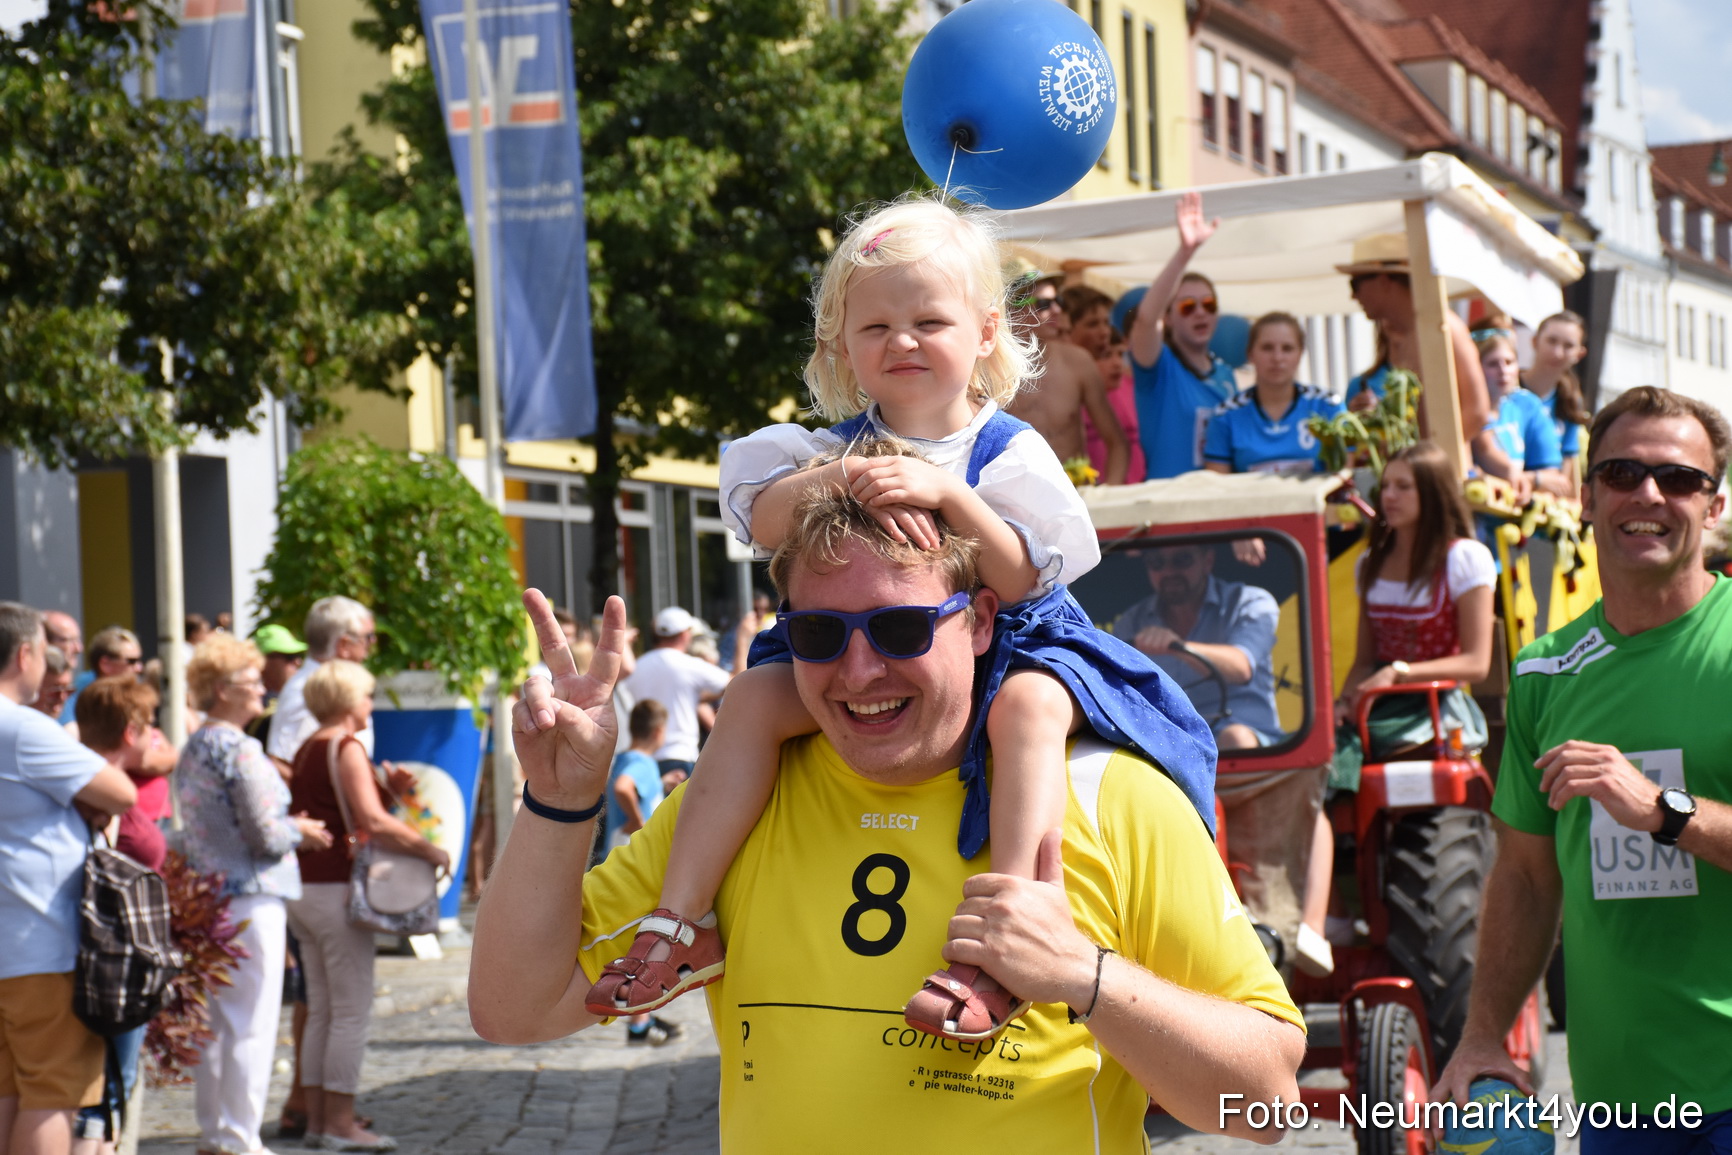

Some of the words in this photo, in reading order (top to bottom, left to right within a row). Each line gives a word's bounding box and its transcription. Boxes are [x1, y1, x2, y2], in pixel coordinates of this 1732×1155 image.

[1039, 66, 1072, 131] WELTWEIT
[1076, 104, 1104, 134] HILFE
[860, 813, 920, 831] SELECT
[1594, 835, 1690, 872] USM
[1597, 881, 1659, 893] FINANZ
[1670, 879, 1693, 891] AG
[841, 853, 910, 957] 8
[987, 1076, 1015, 1090] 92318
